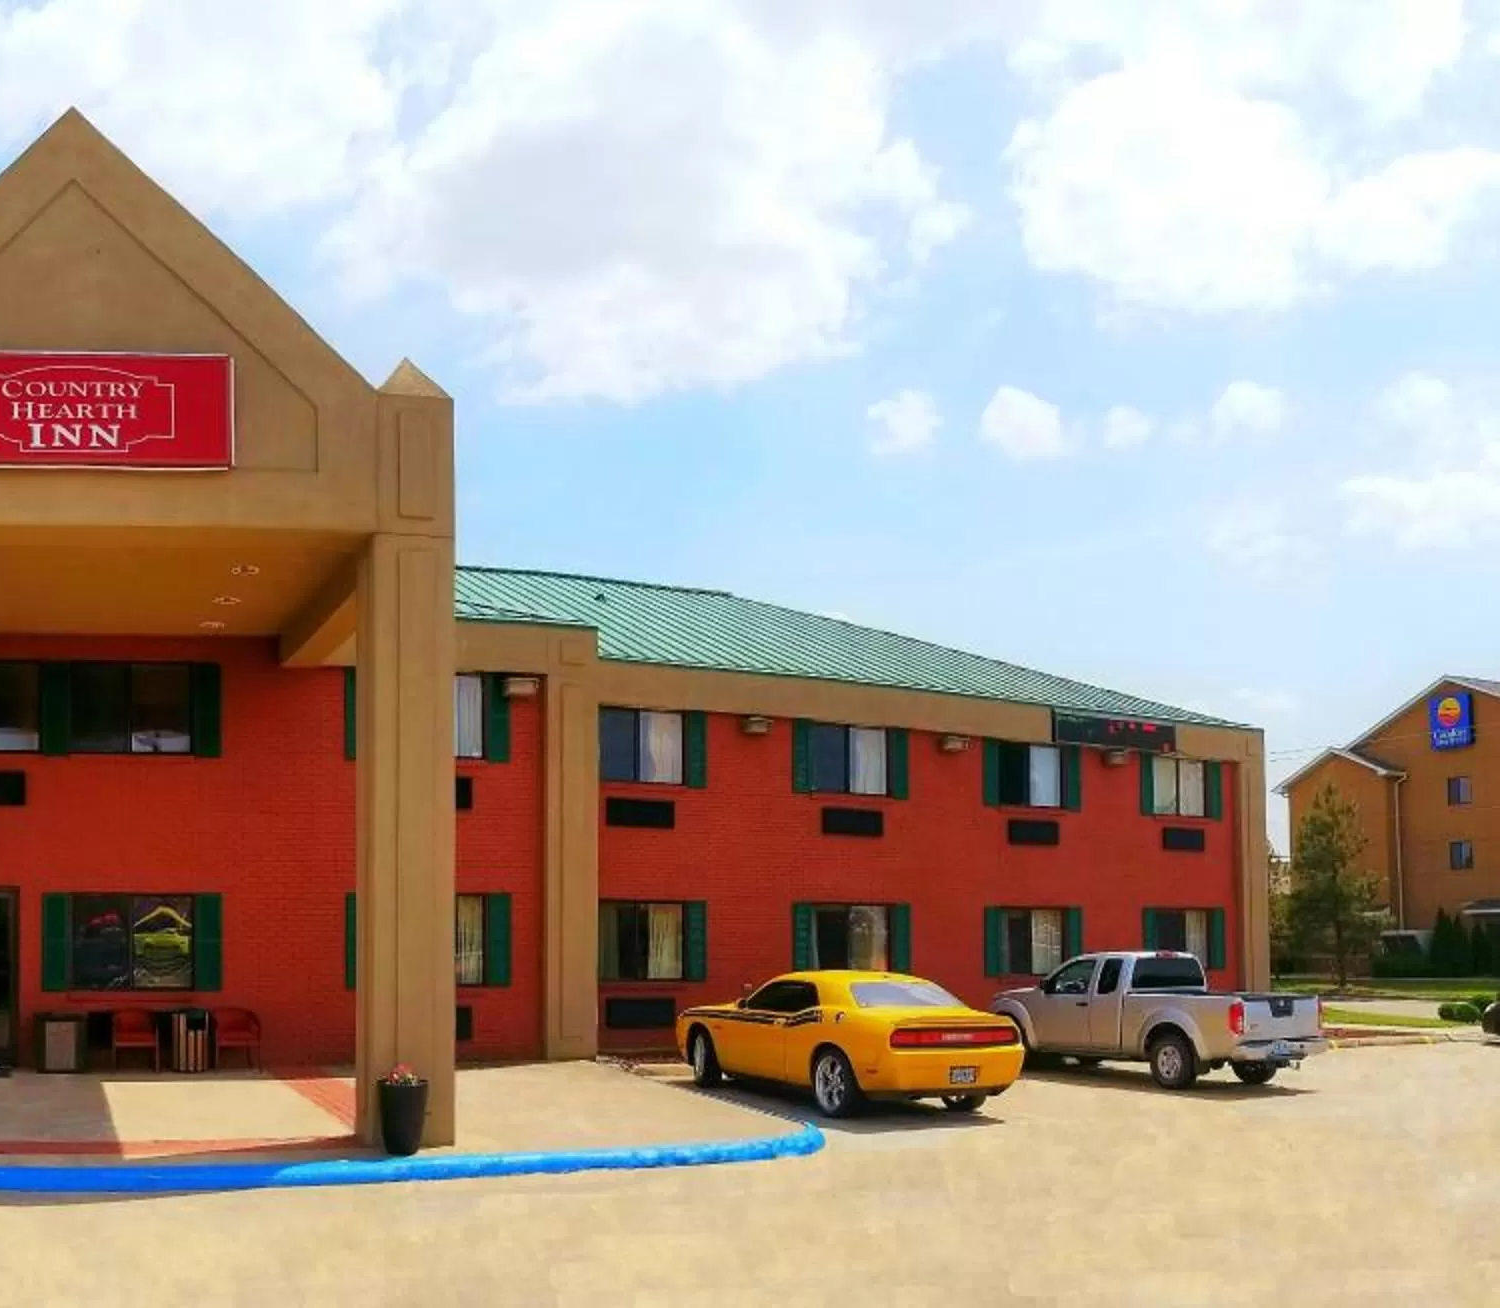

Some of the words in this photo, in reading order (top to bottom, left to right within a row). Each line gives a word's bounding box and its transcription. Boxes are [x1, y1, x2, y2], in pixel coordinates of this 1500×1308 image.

[2, 380, 143, 398] COUNTRY
[12, 401, 137, 419] HEARTH
[28, 423, 120, 447] INN
